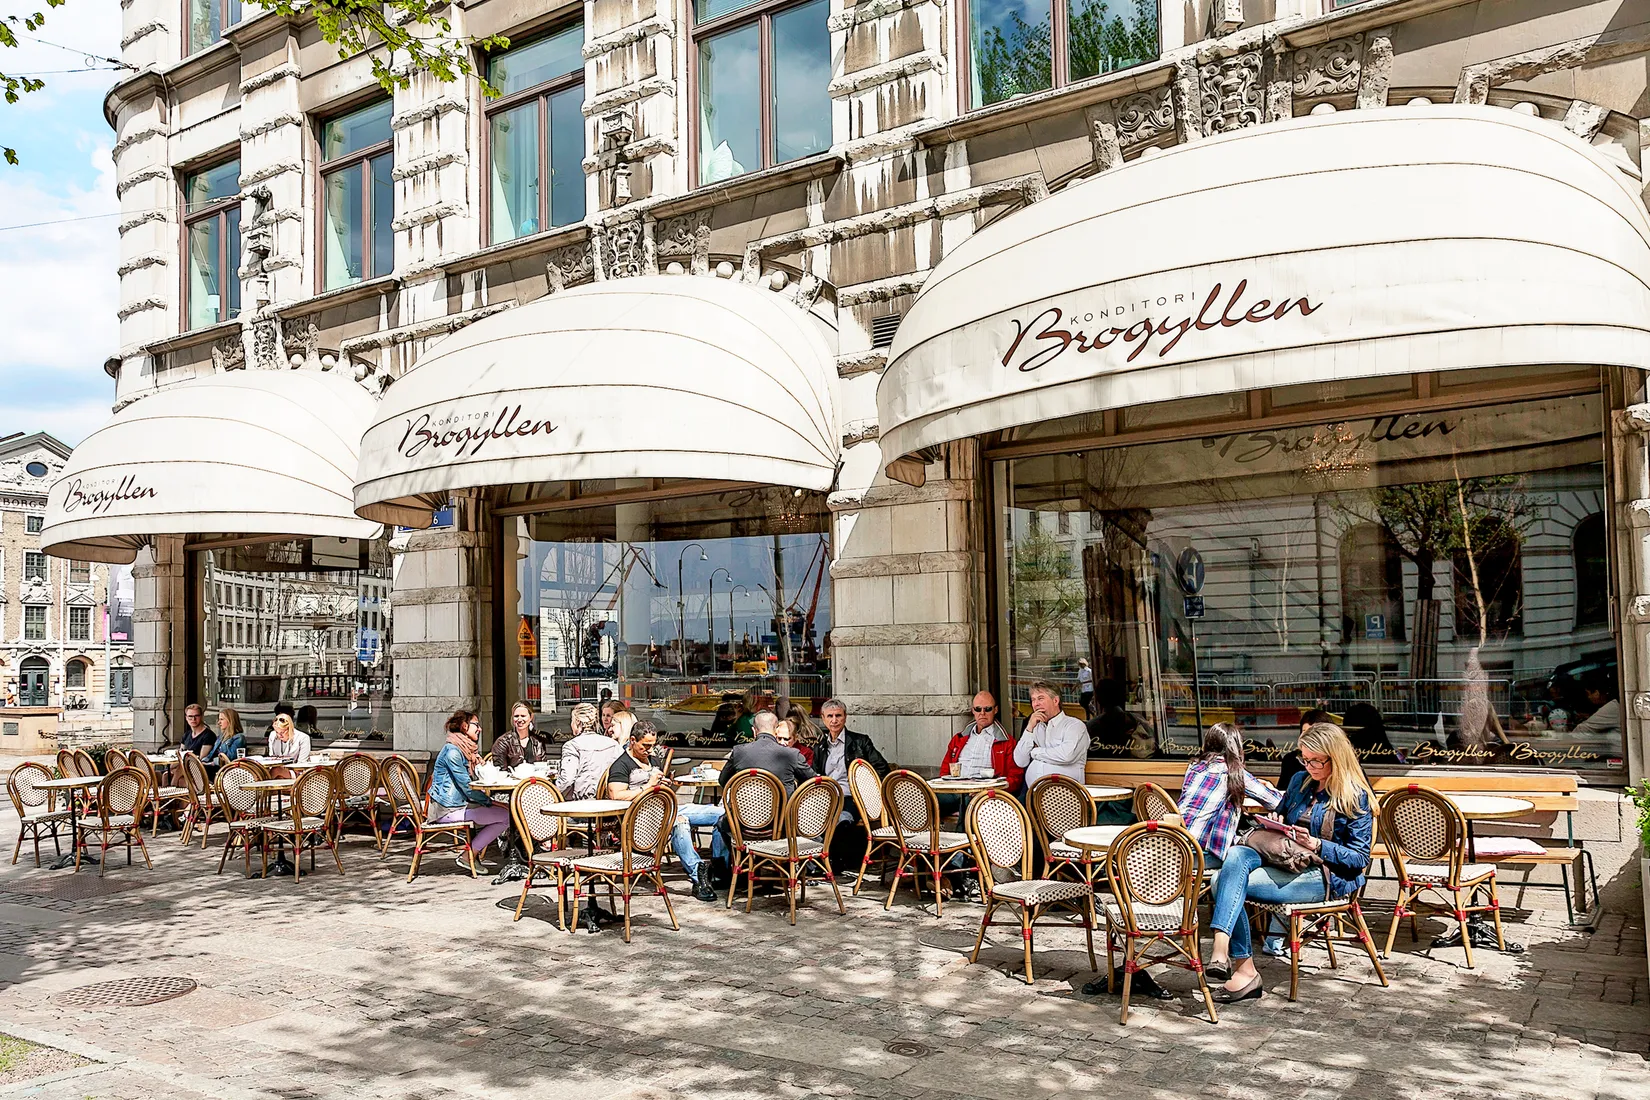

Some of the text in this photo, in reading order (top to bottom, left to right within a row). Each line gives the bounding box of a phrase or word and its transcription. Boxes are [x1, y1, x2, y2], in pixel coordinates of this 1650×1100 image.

[1069, 291, 1197, 325] KONDITORI
[1000, 278, 1324, 373] Brogyllen
[397, 404, 559, 458] Brogyllen
[431, 411, 496, 427] KONDITORI
[1, 497, 46, 508] BORGS
[62, 473, 158, 515] Brogyllen
[433, 515, 439, 525] 6
[1088, 736, 1149, 757] Brogyllen
[1242, 738, 1298, 760] Brogyll
[1510, 741, 1601, 764] Brogyllen
